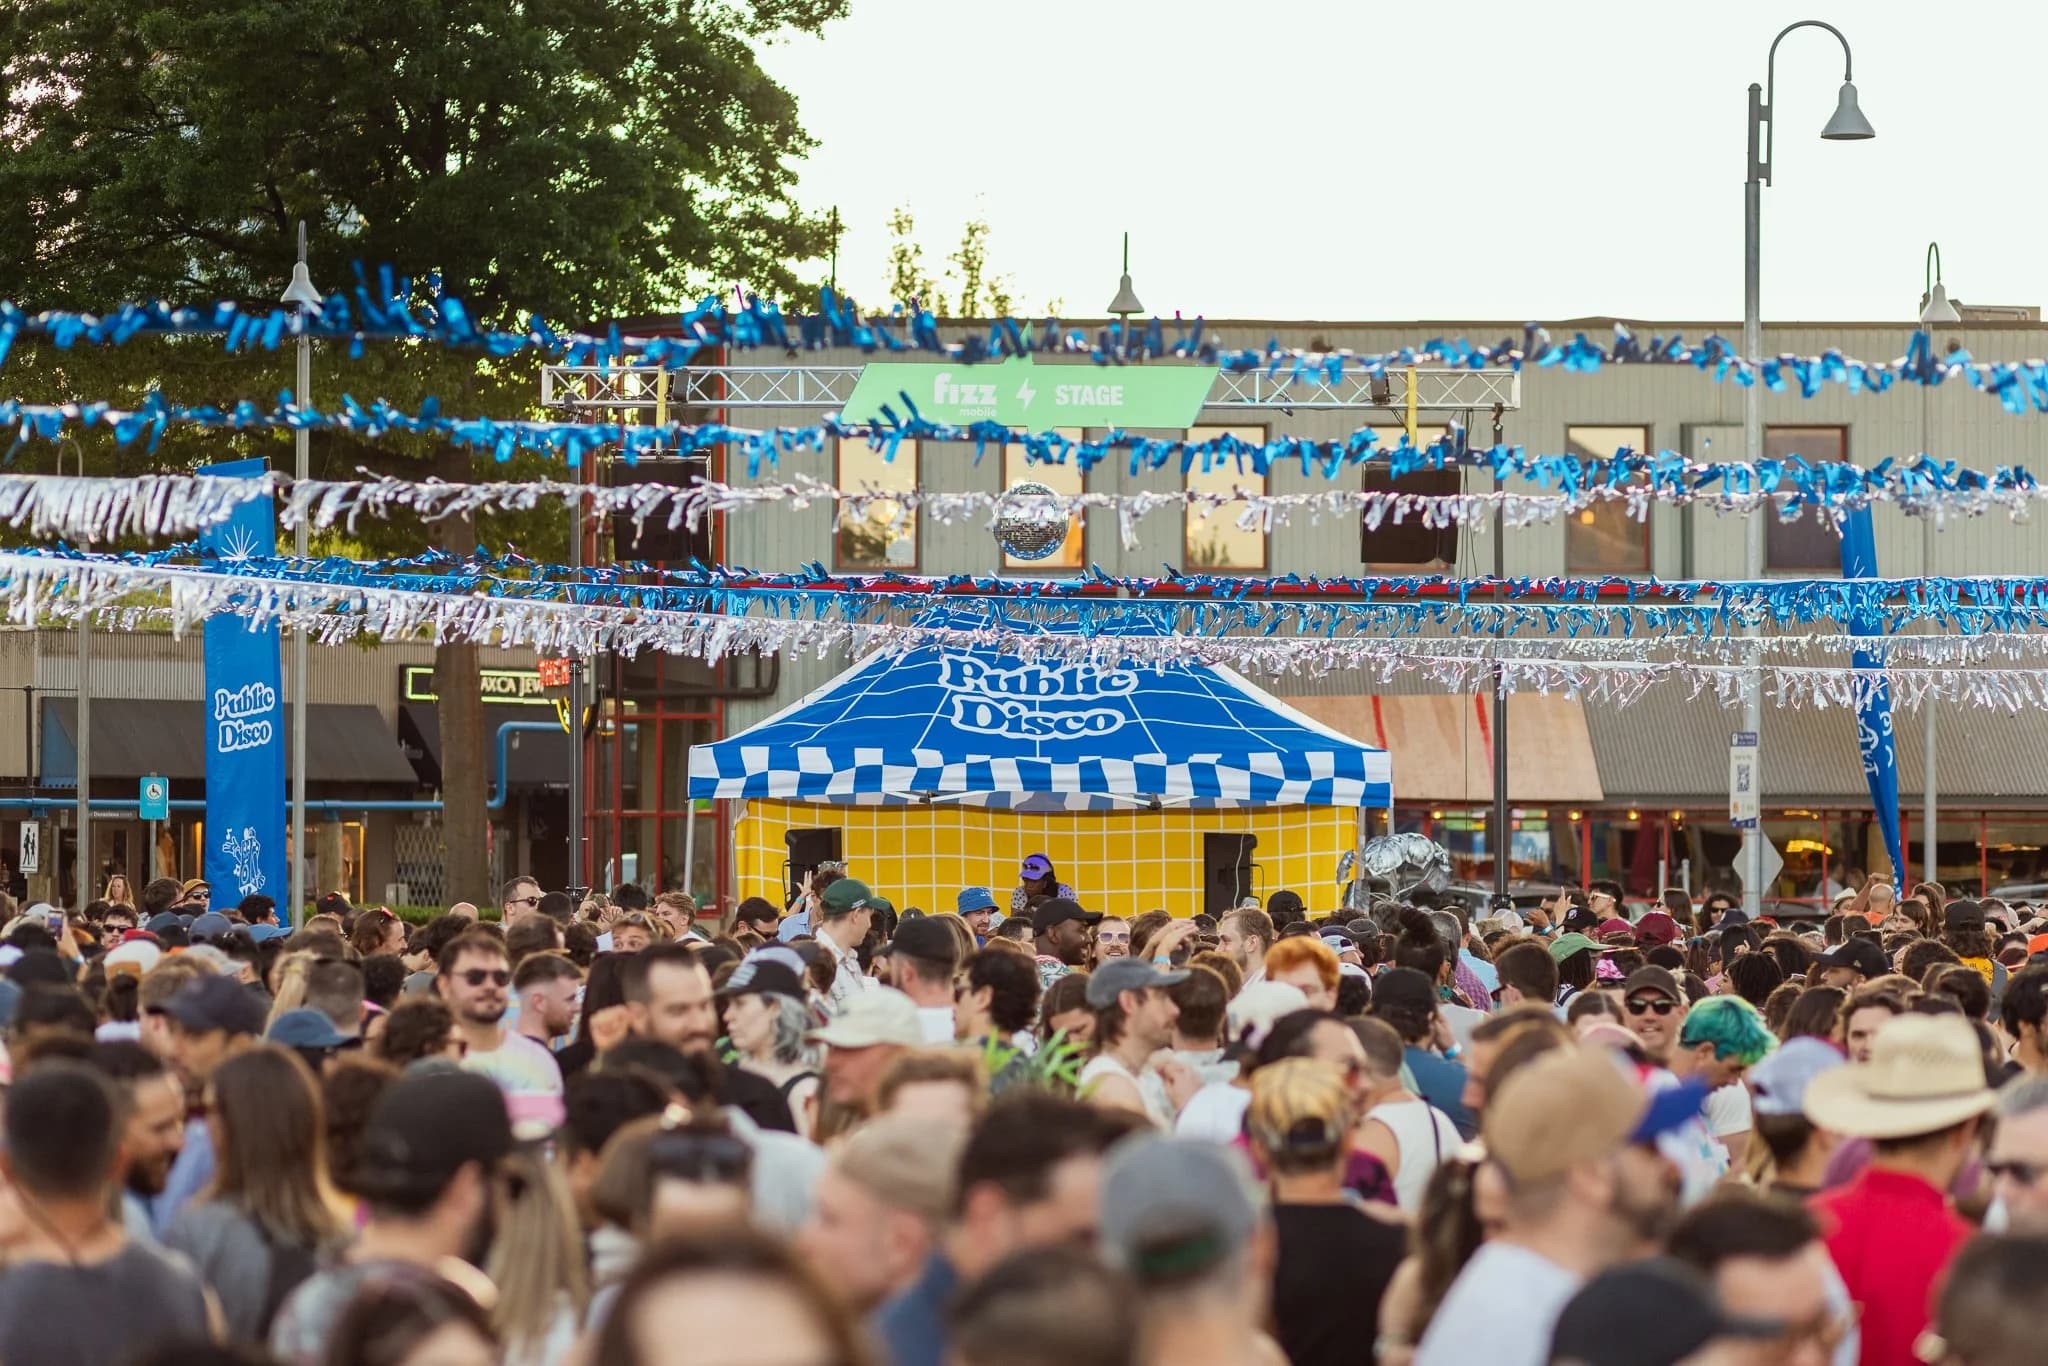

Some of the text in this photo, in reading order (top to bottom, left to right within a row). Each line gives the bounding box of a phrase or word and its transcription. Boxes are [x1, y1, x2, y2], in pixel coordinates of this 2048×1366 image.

[934, 372, 1124, 406] fizz STAGE
[960, 407, 997, 417] mobile
[939, 654, 1139, 700] Public
[215, 682, 275, 720] Public
[951, 695, 1125, 740] Disco
[218, 719, 272, 752] Disco
